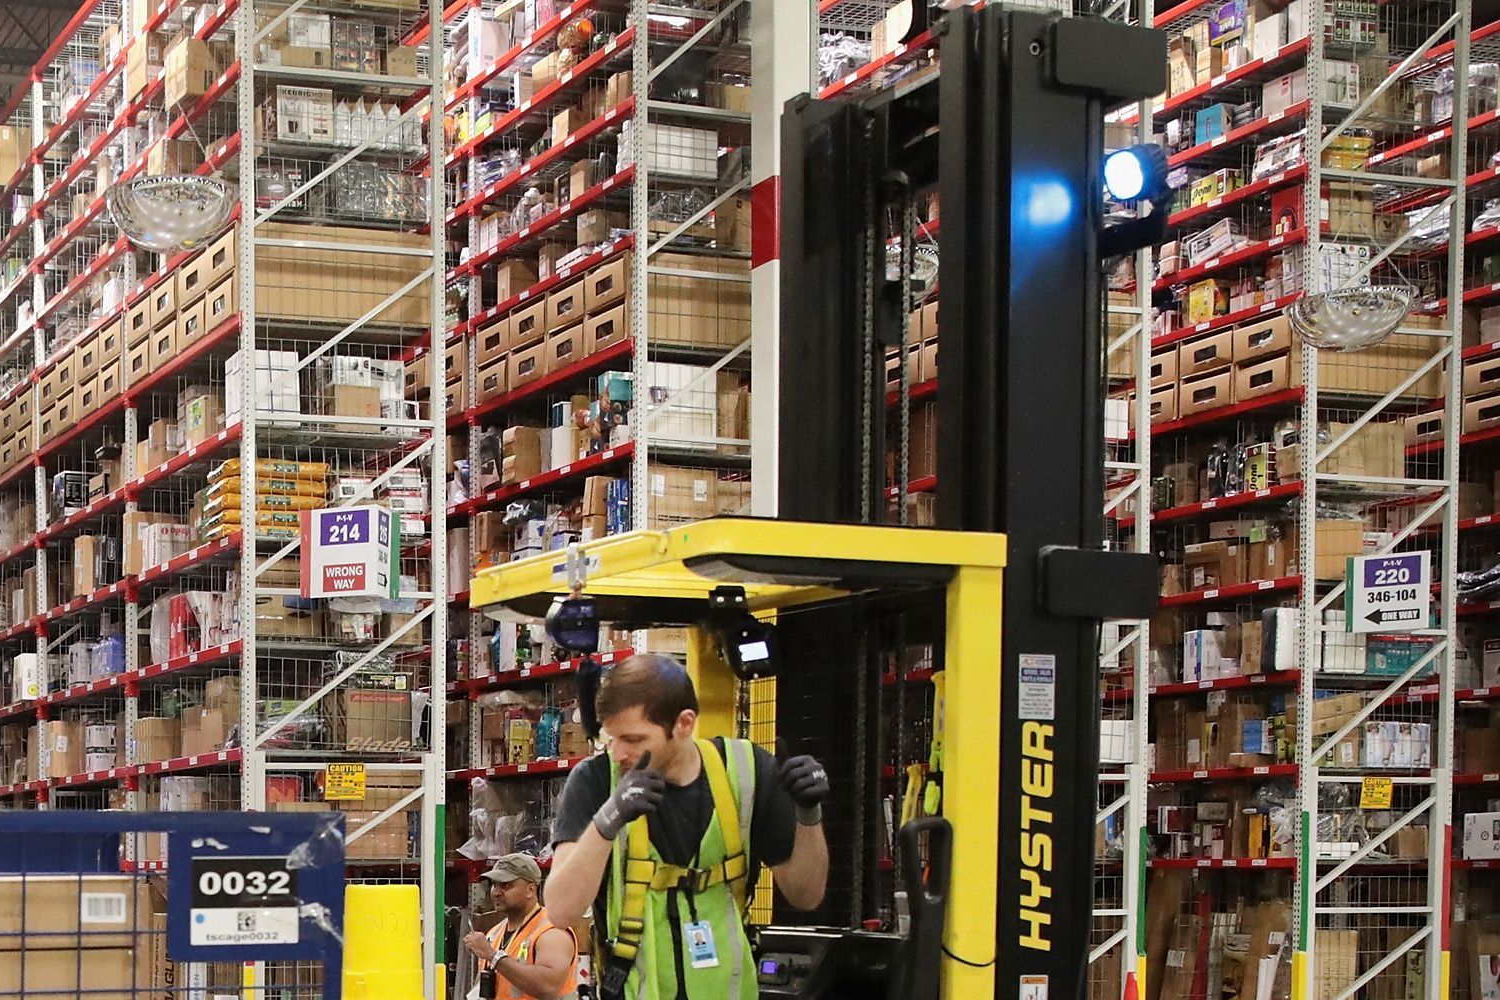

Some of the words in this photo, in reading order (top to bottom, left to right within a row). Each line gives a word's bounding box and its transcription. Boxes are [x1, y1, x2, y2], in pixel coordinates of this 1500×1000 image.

[282, 89, 311, 97] KEURIG
[336, 514, 353, 522] P-1-V
[329, 523, 360, 543] 214
[1383, 559, 1403, 567] P-1-V
[325, 565, 363, 578] WRONG
[1374, 568, 1410, 585] 220
[333, 579, 355, 590] WAY
[1381, 612, 1398, 621] ONE
[1398, 610, 1418, 620] WAY
[1019, 720, 1054, 951] HYSTER
[198, 870, 291, 896] 0032
[206, 931, 279, 942] tscage0032
